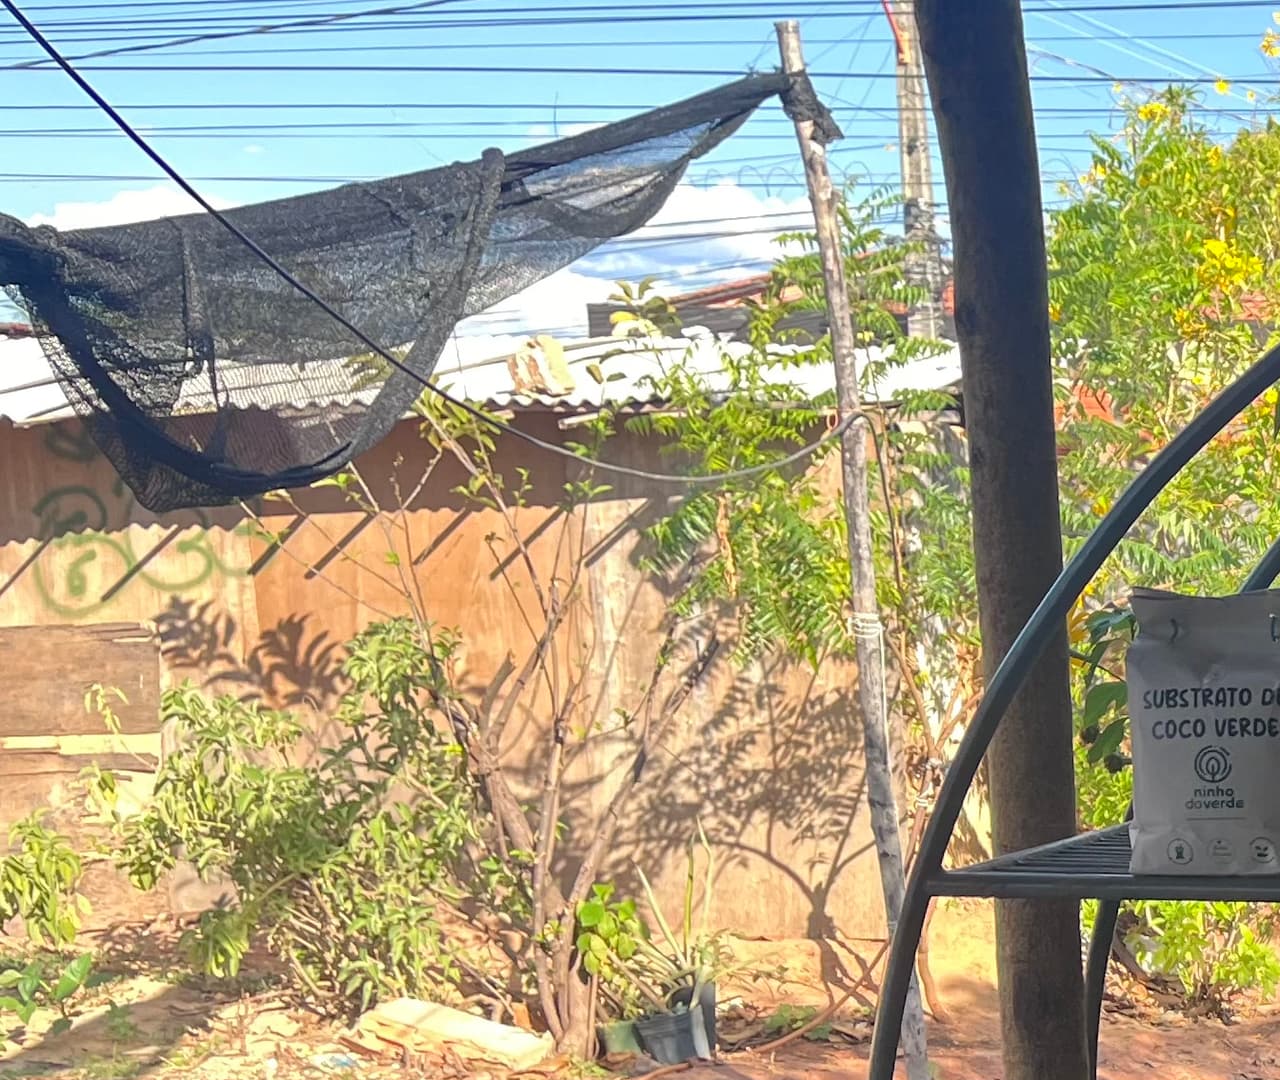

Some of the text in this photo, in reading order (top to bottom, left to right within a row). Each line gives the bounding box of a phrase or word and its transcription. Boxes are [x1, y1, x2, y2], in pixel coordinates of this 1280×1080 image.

[1143, 687, 1252, 709] SUBSTRATO
[1152, 717, 1280, 740] COCO VERDE
[1193, 786, 1234, 797] ninho
